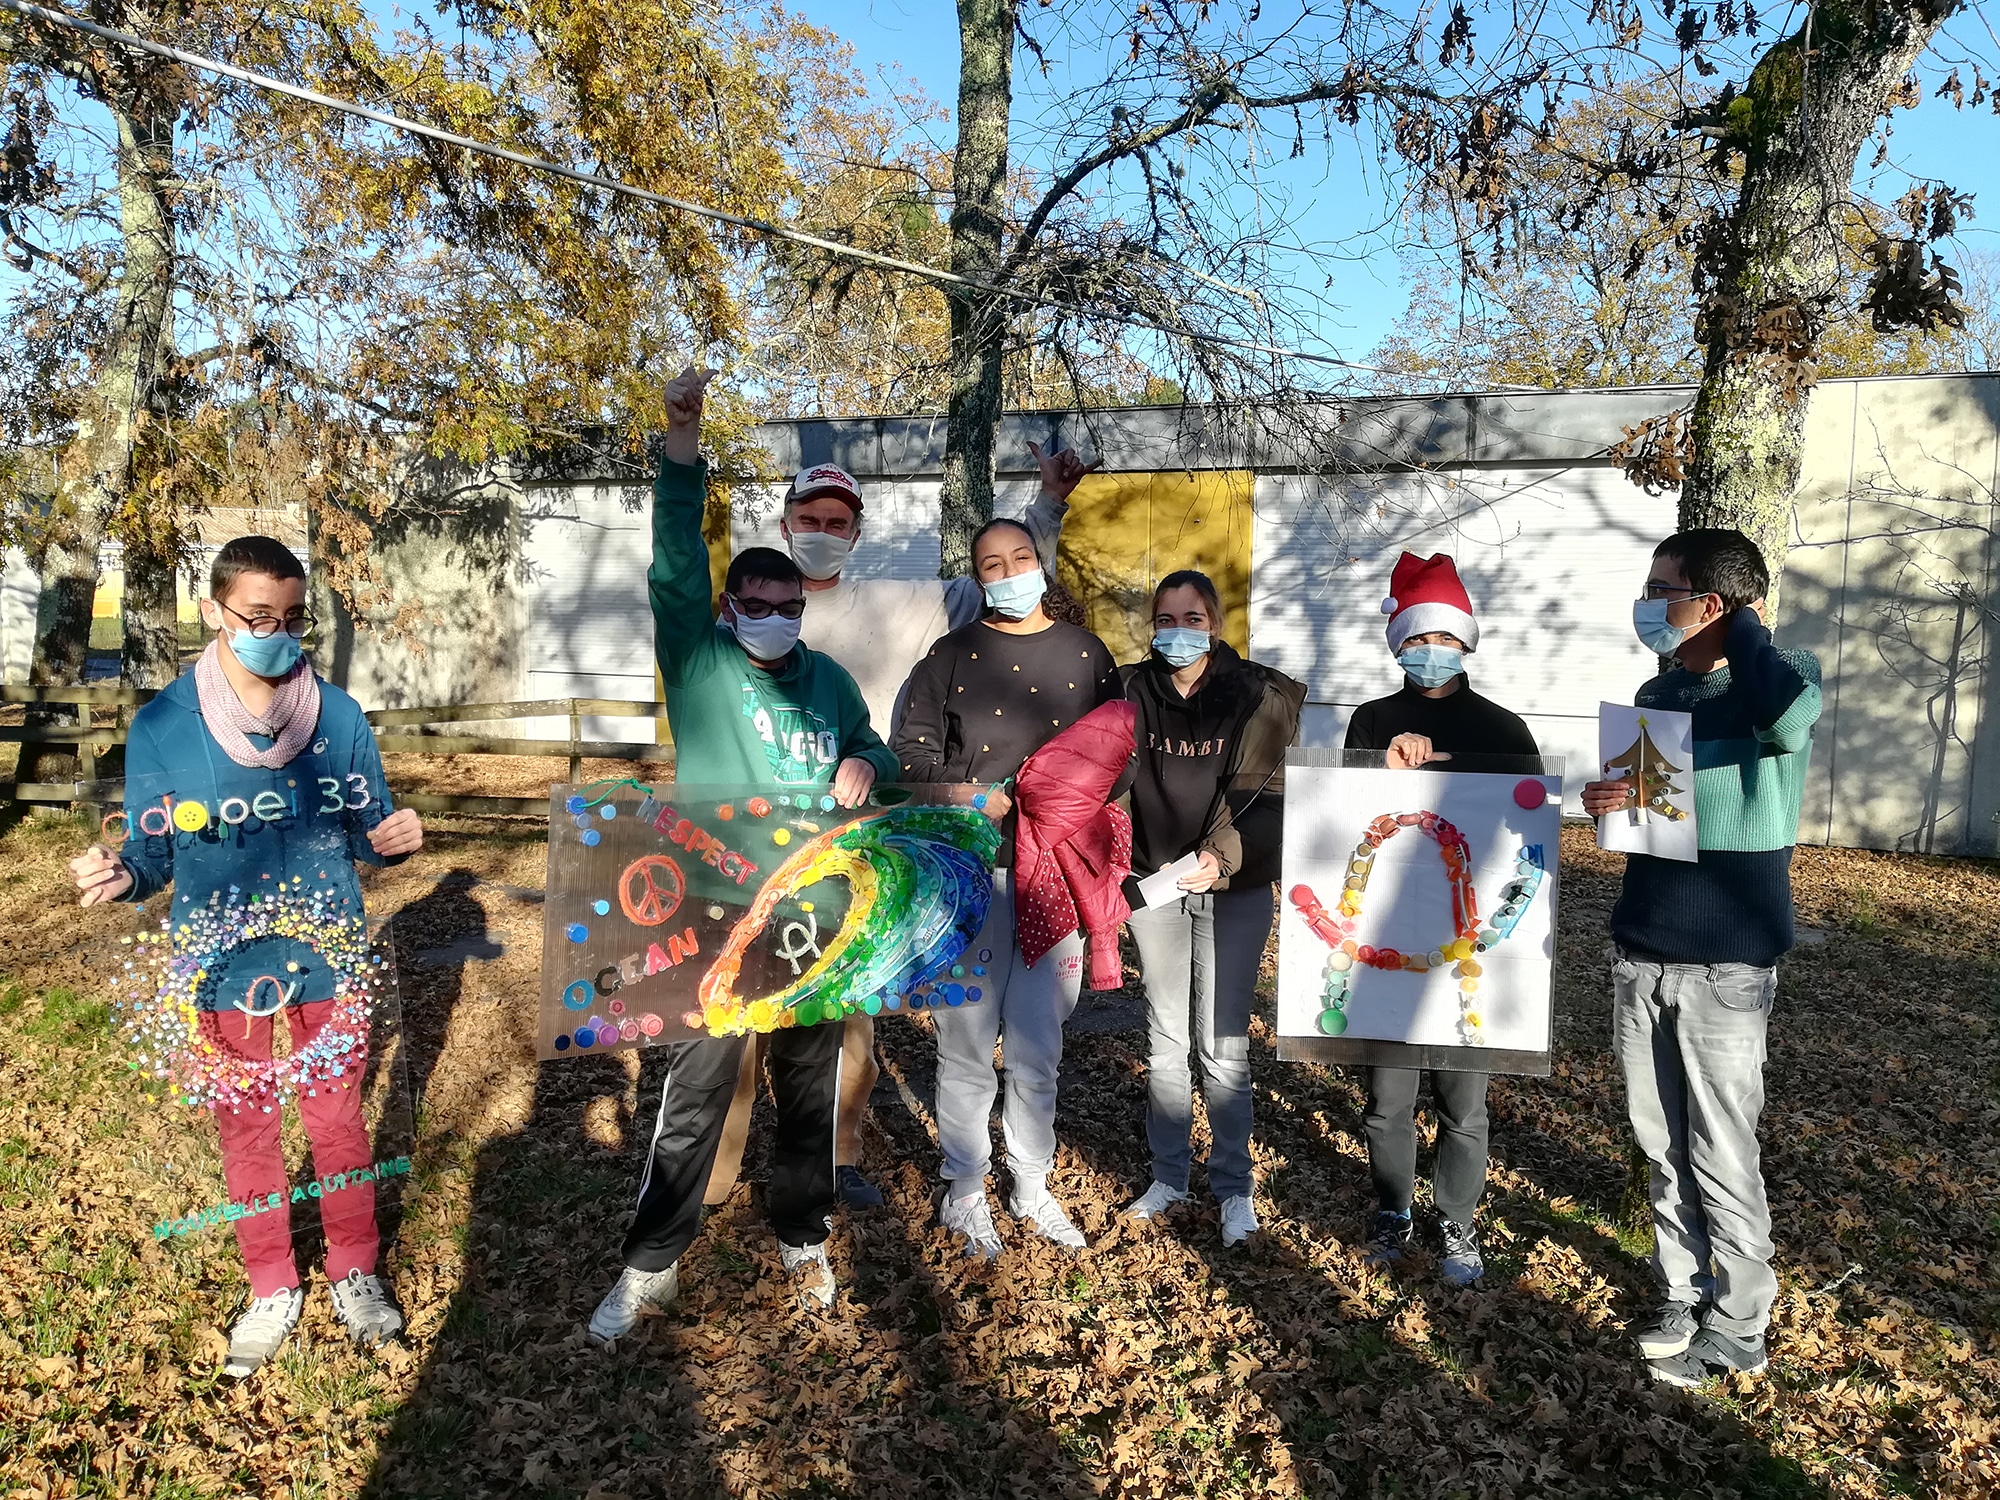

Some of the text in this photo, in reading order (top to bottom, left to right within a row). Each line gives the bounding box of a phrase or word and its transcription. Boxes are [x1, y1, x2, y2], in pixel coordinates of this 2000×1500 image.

[1145, 732, 1225, 757] BAMBI
[317, 773, 370, 816] 33
[635, 794, 758, 886] RESPECT
[562, 927, 700, 1012] OCEAN
[153, 1156, 411, 1240] NOUVELLE AQUITAINE
